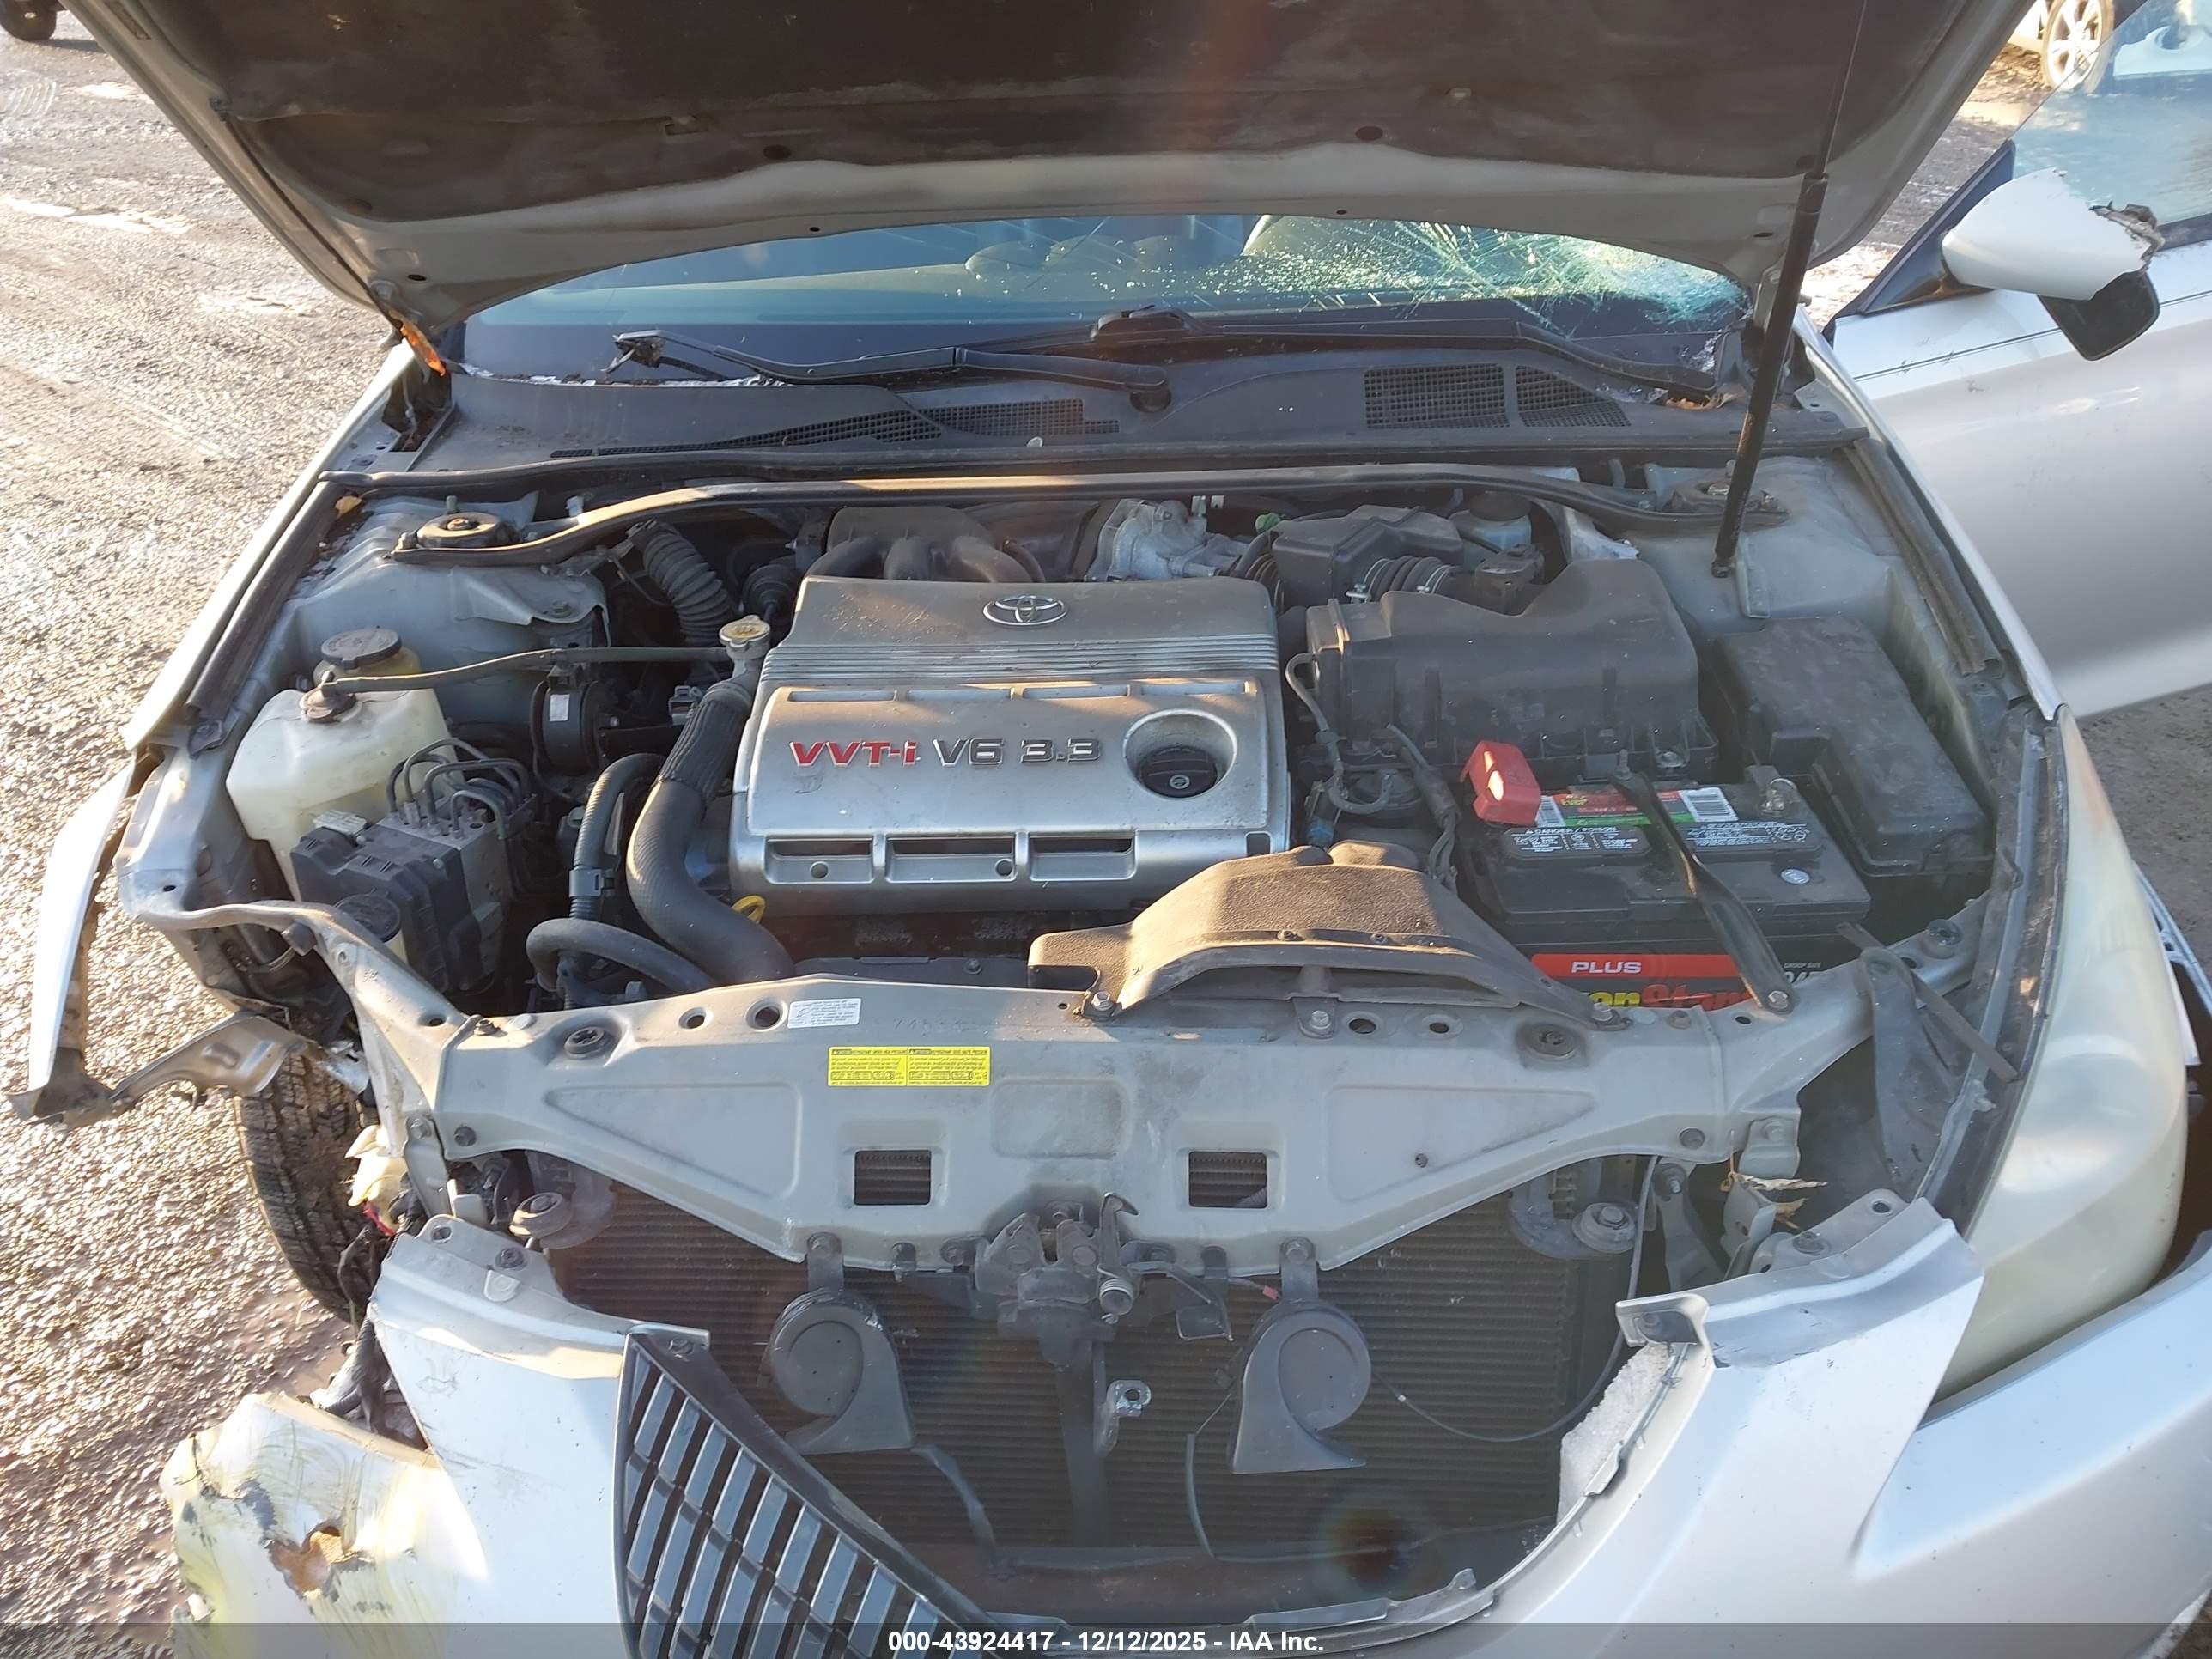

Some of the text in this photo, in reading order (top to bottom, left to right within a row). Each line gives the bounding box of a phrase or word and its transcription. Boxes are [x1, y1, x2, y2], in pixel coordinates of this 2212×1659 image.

[789, 738, 1101, 767] VVT-i V6 3.3
[1571, 961, 1642, 974] PLUS
